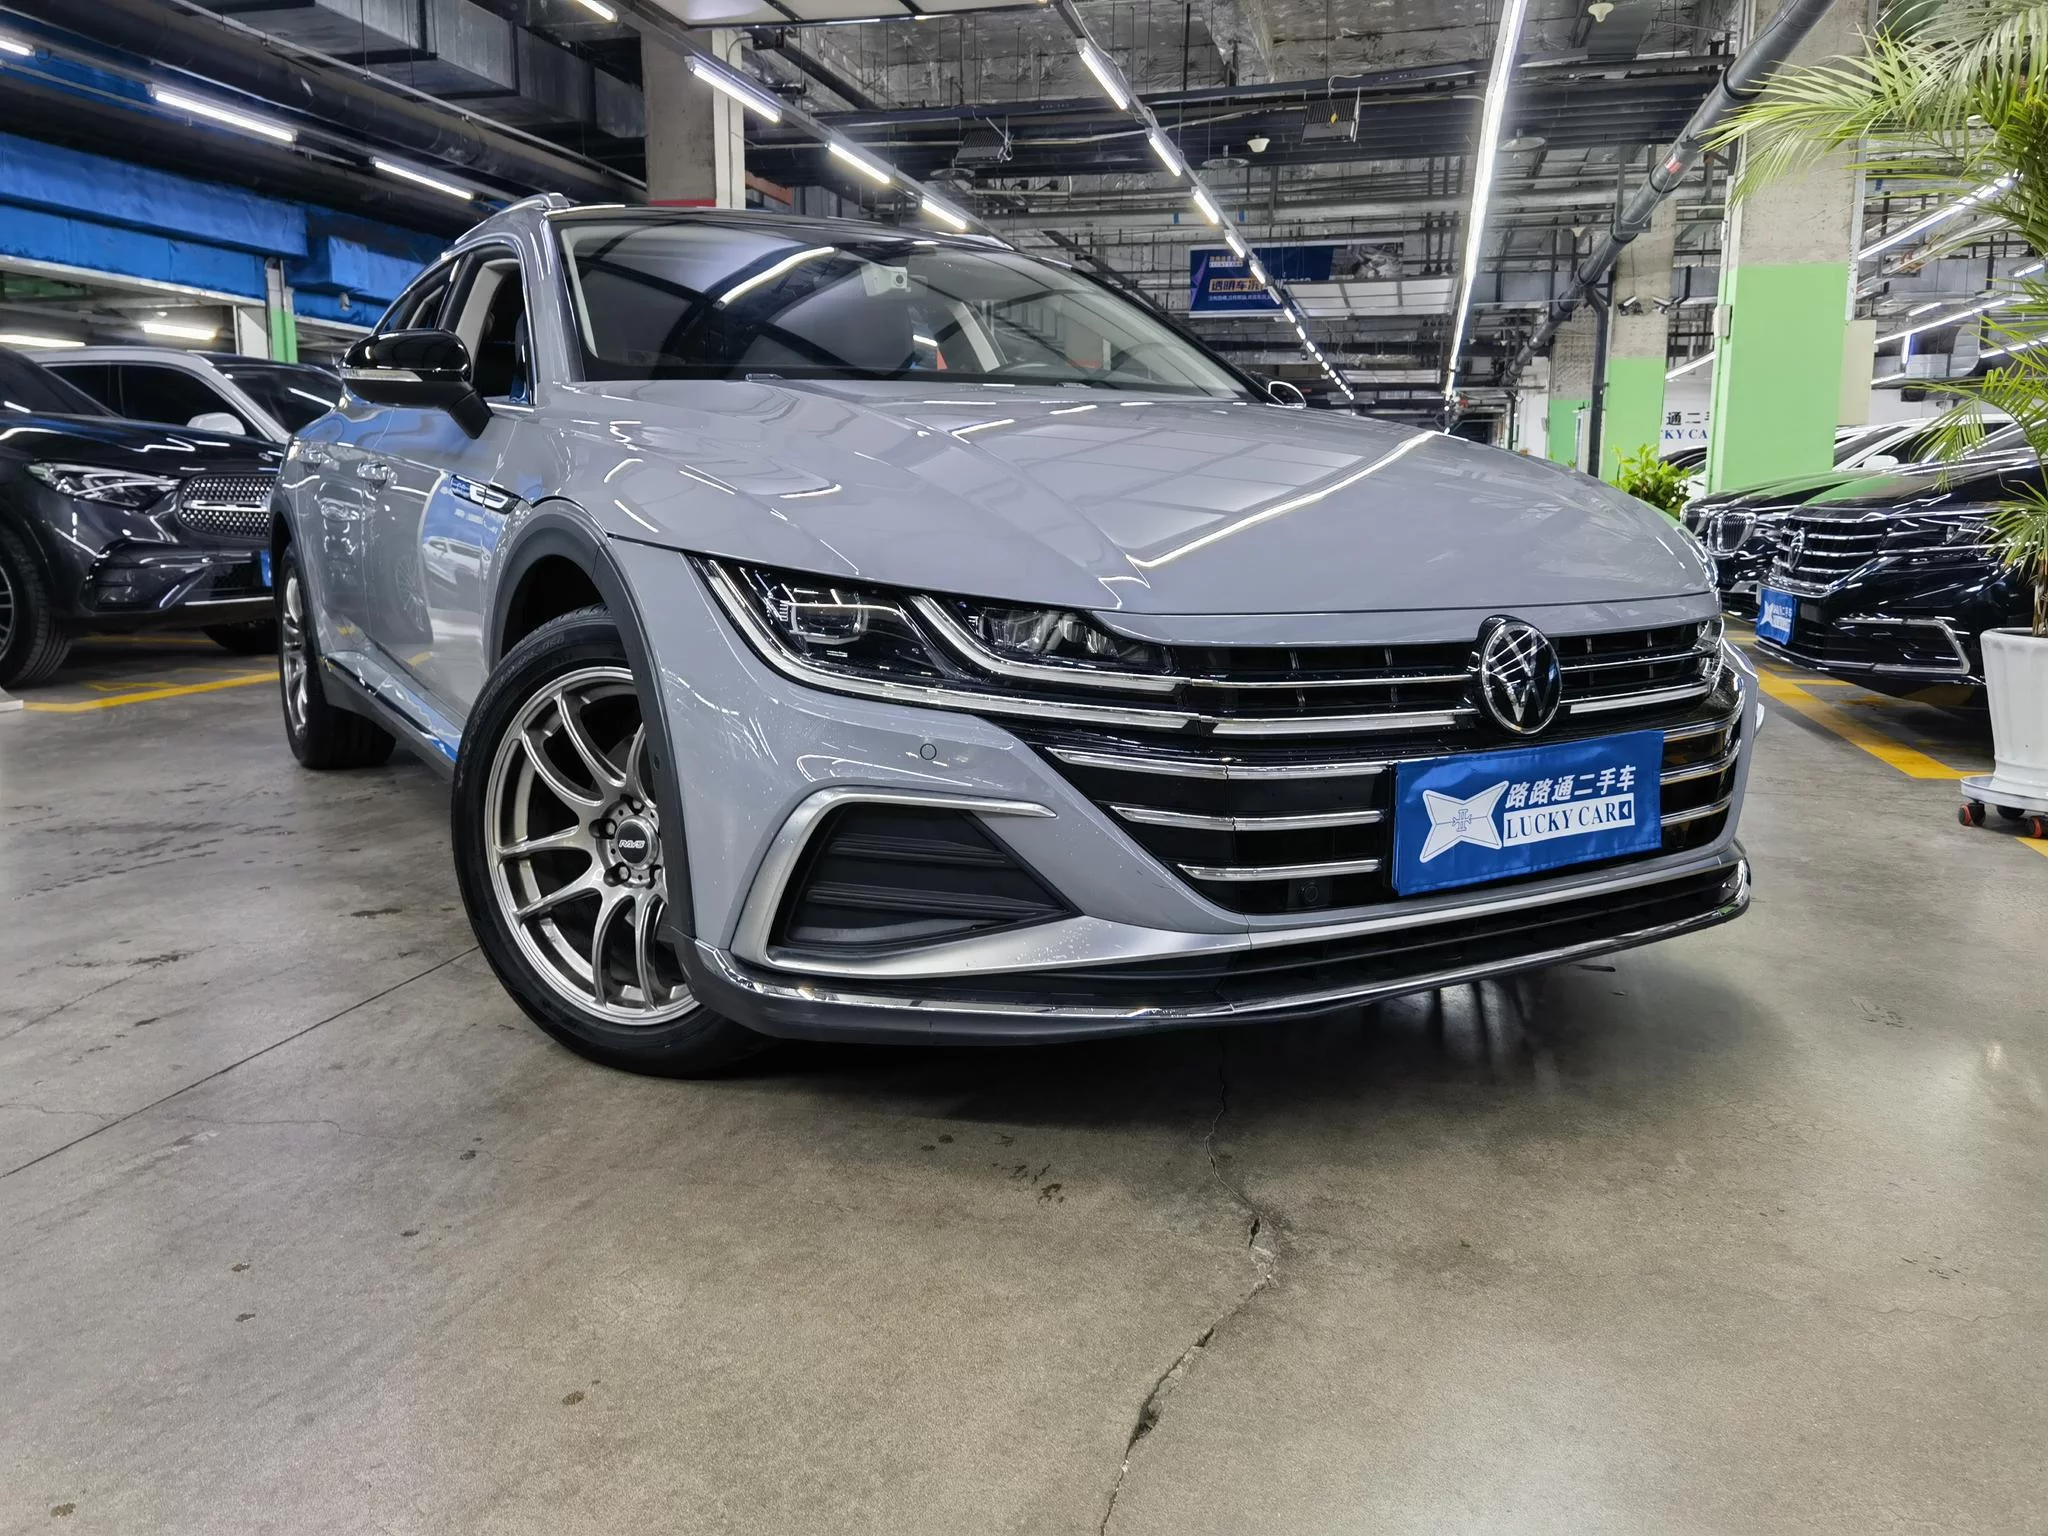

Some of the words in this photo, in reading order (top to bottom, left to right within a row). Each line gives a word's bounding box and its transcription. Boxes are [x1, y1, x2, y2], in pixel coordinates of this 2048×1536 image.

[1660, 429, 1684, 440] KY
[1505, 764, 1637, 809] 路路通二手车
[1506, 808, 1573, 840] LUCKY
[1579, 802, 1617, 827] CAR
[619, 839, 646, 849] RAYS
